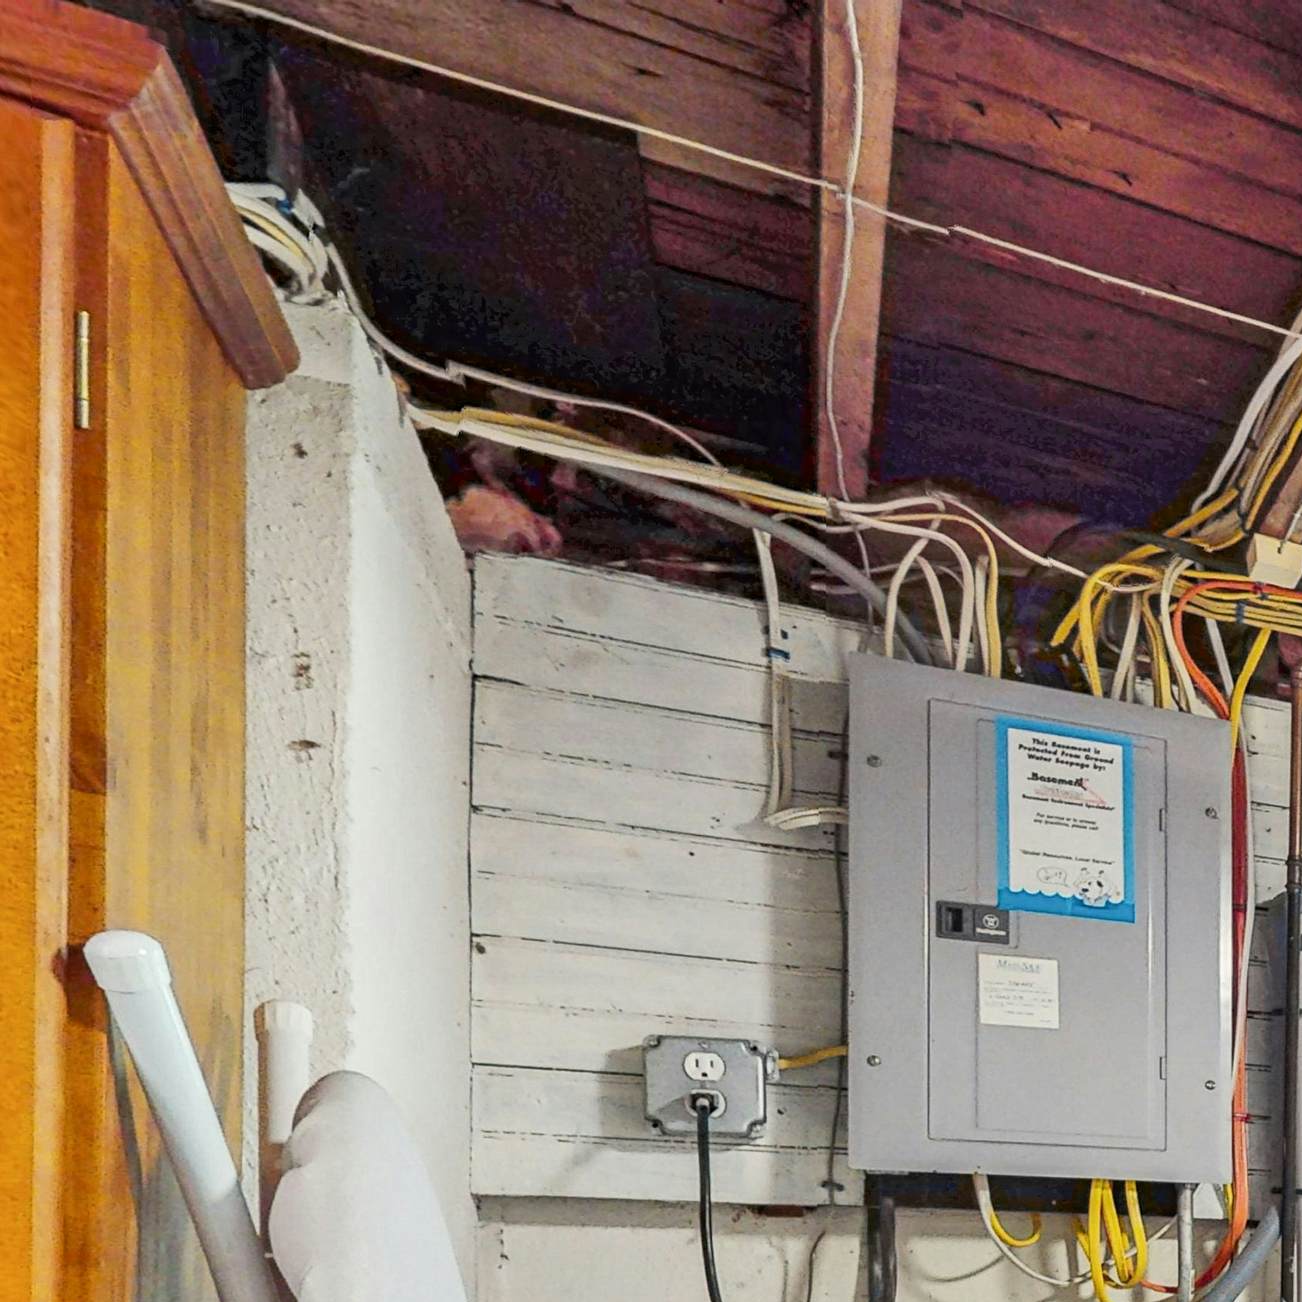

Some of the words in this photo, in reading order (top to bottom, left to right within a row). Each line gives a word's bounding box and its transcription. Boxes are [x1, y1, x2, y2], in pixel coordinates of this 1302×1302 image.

[1031, 737, 1048, 746] This
[1052, 741, 1091, 752] Basement
[1018, 743, 1058, 756] Protected
[1084, 754, 1114, 764] Ground
[1027, 753, 1052, 762] Water
[1055, 757, 1090, 769] Seepage
